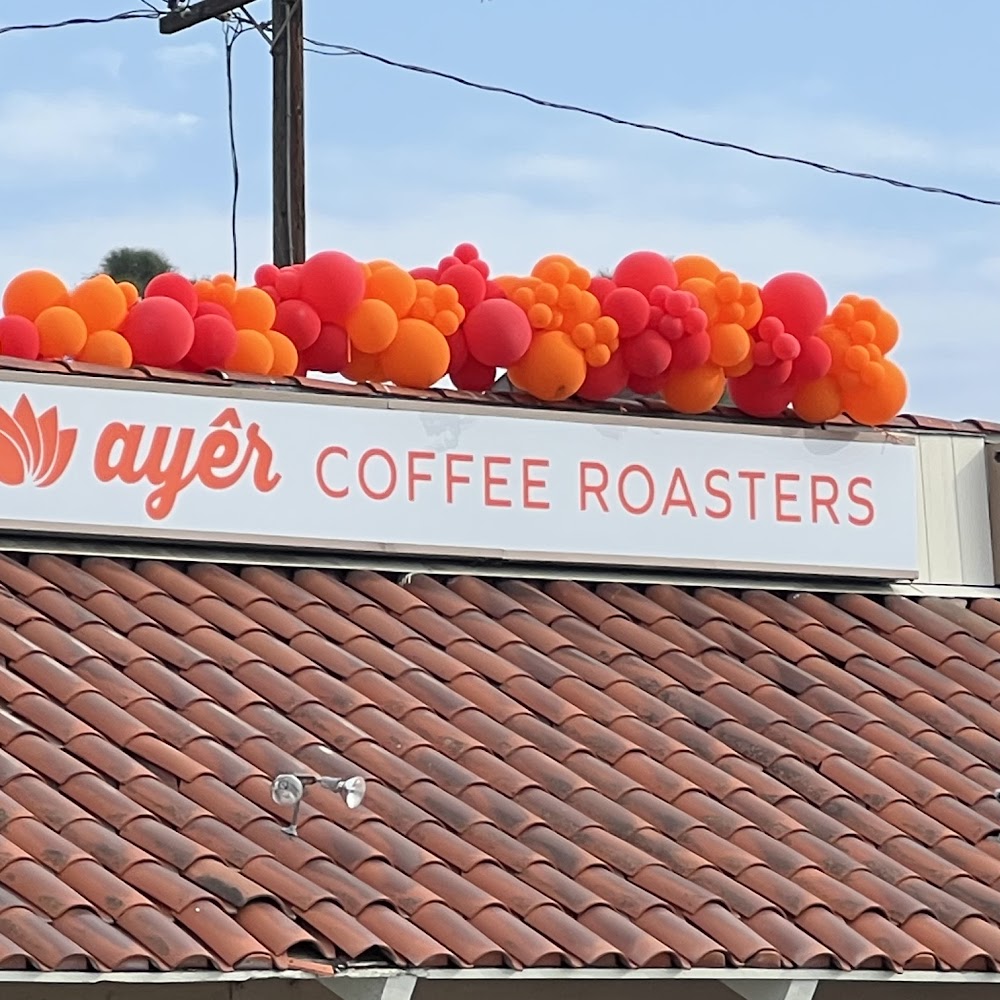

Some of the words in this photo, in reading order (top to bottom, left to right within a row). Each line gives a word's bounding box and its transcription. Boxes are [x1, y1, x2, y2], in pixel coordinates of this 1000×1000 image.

[95, 408, 281, 520] ayêr
[316, 446, 550, 509] COFFEE
[580, 461, 874, 526] ROASTERS
